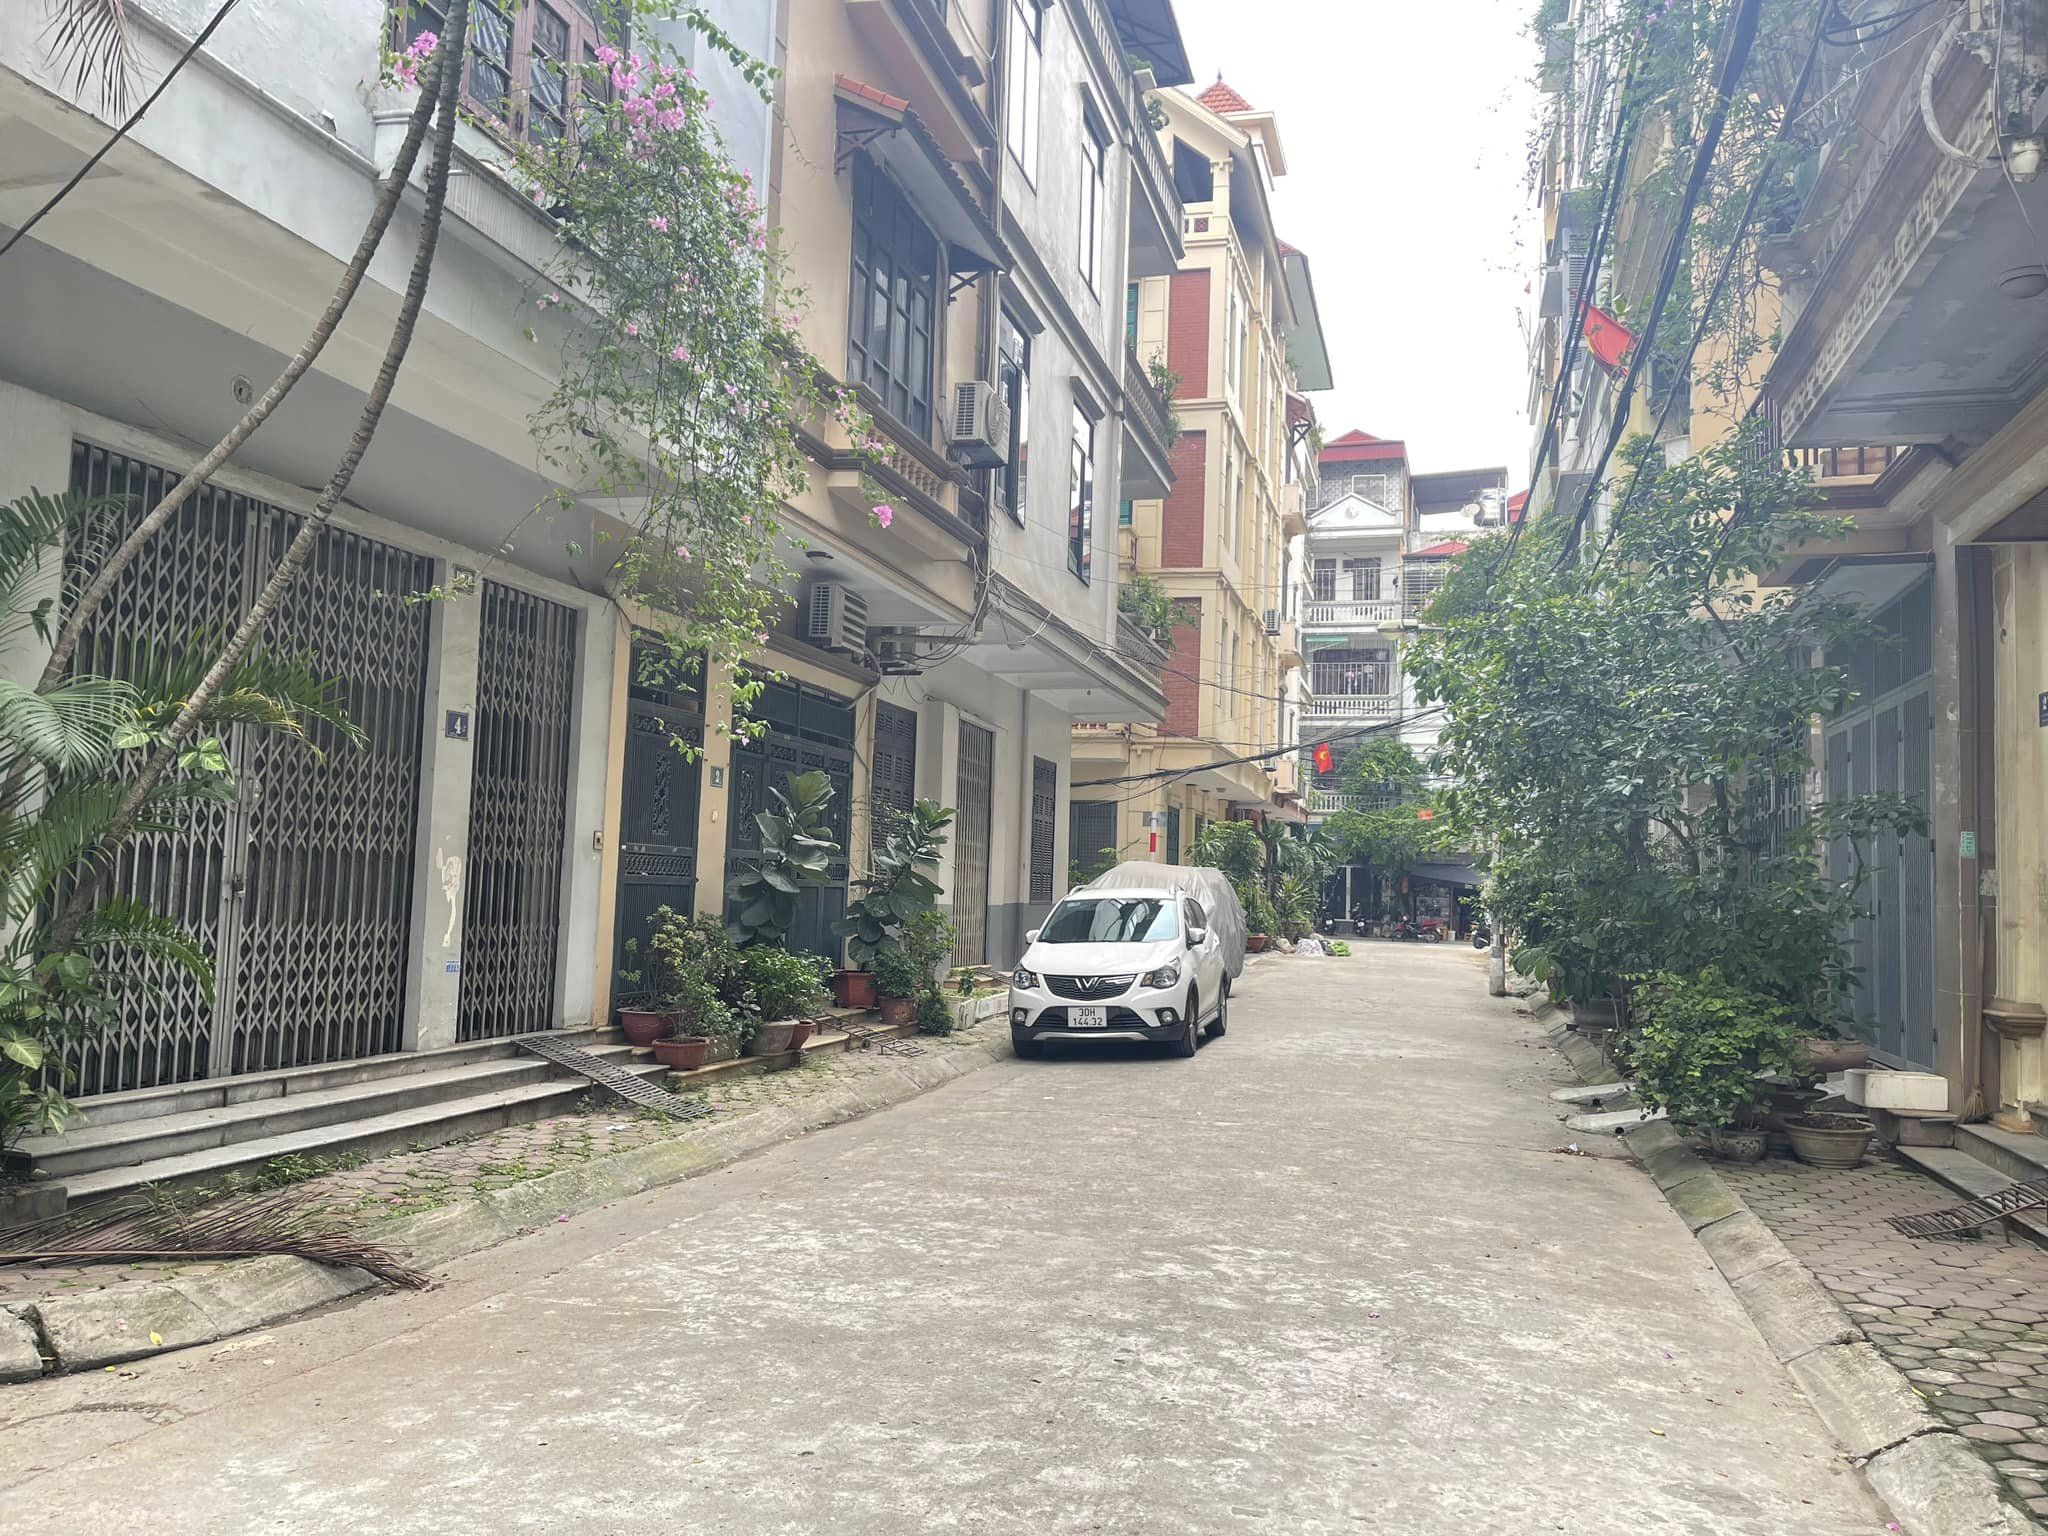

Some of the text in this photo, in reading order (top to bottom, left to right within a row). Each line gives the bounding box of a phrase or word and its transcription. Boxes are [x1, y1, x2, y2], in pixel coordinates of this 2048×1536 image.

[454, 716, 461, 734] 4
[1079, 1007, 1096, 1016] 30H
[1073, 1017, 1103, 1026] 144.32
